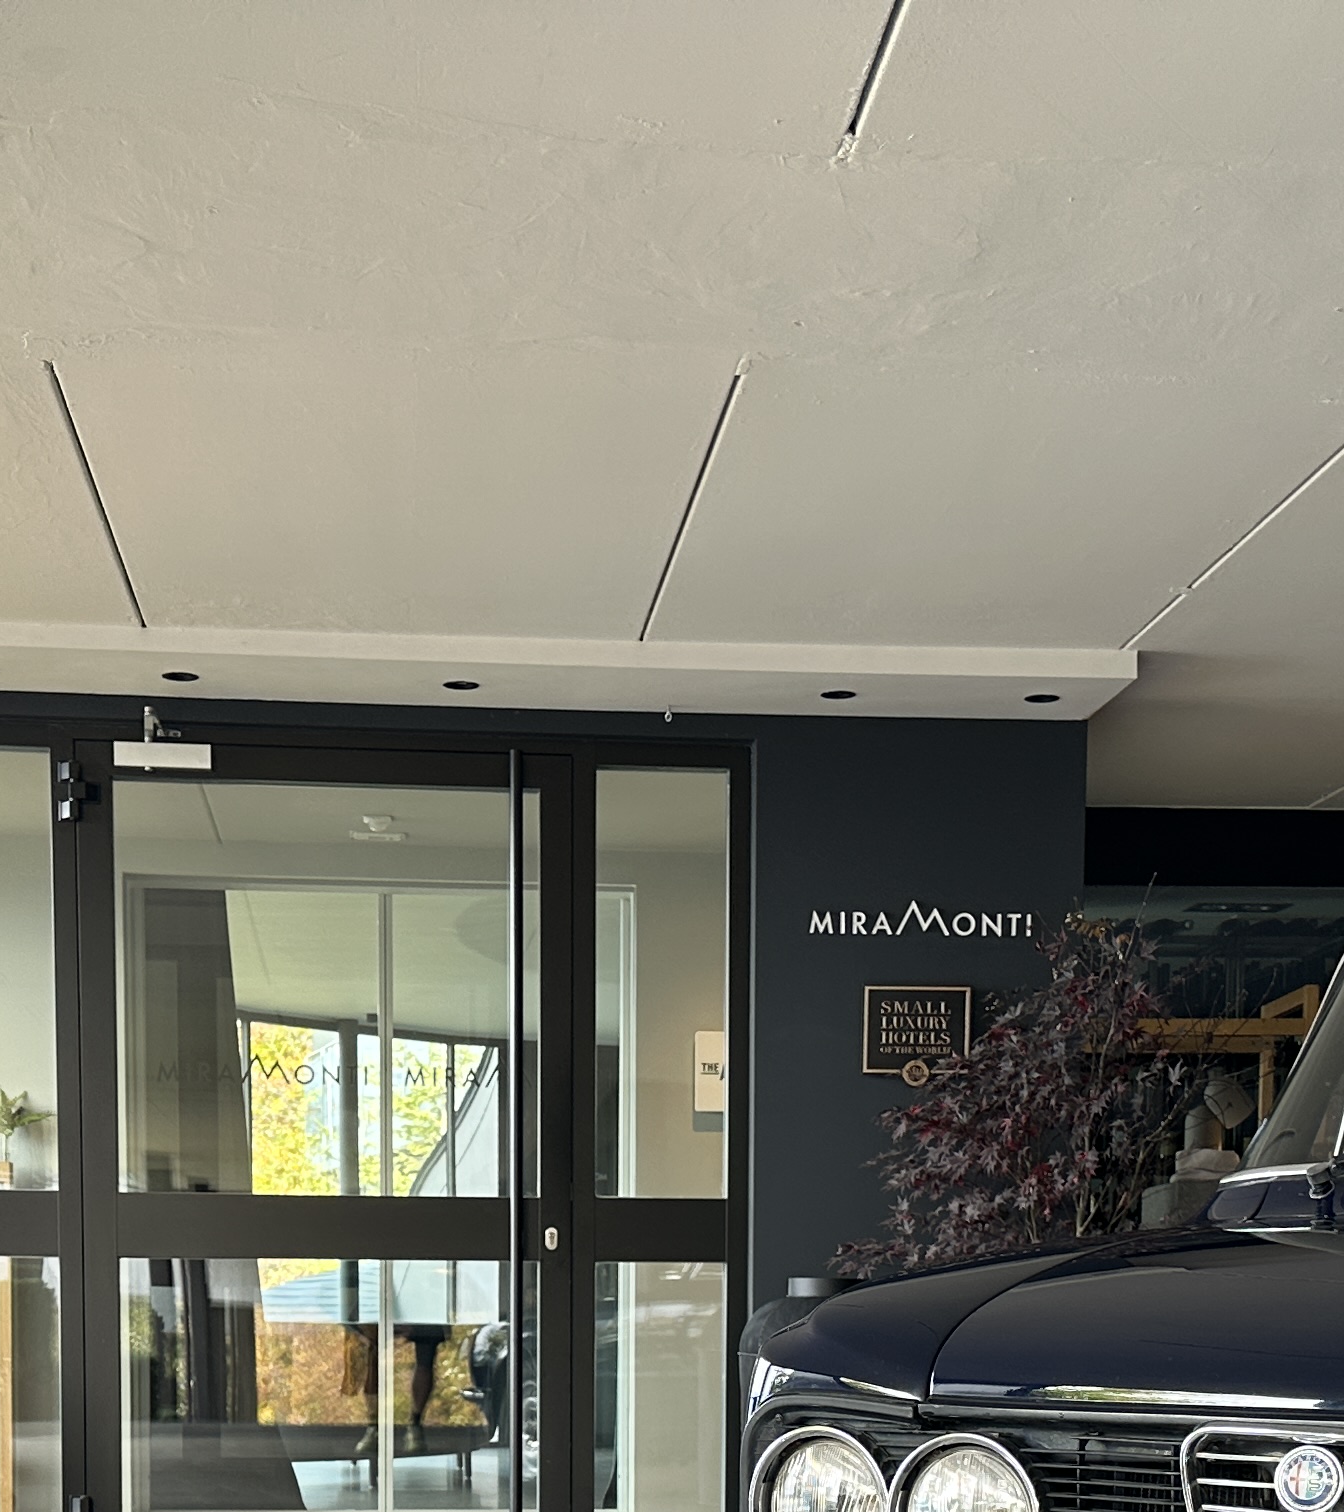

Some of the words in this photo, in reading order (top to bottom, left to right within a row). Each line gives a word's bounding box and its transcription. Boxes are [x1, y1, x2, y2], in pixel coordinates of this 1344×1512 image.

[809, 900, 1032, 938] MIRAMONTI
[880, 1001, 952, 1014] SMALL
[880, 1016, 950, 1029] LUXURY
[879, 1031, 951, 1045] HOTELS
[879, 1046, 892, 1054] OF
[894, 1046, 914, 1054] THE
[701, 1063, 719, 1072] THE
